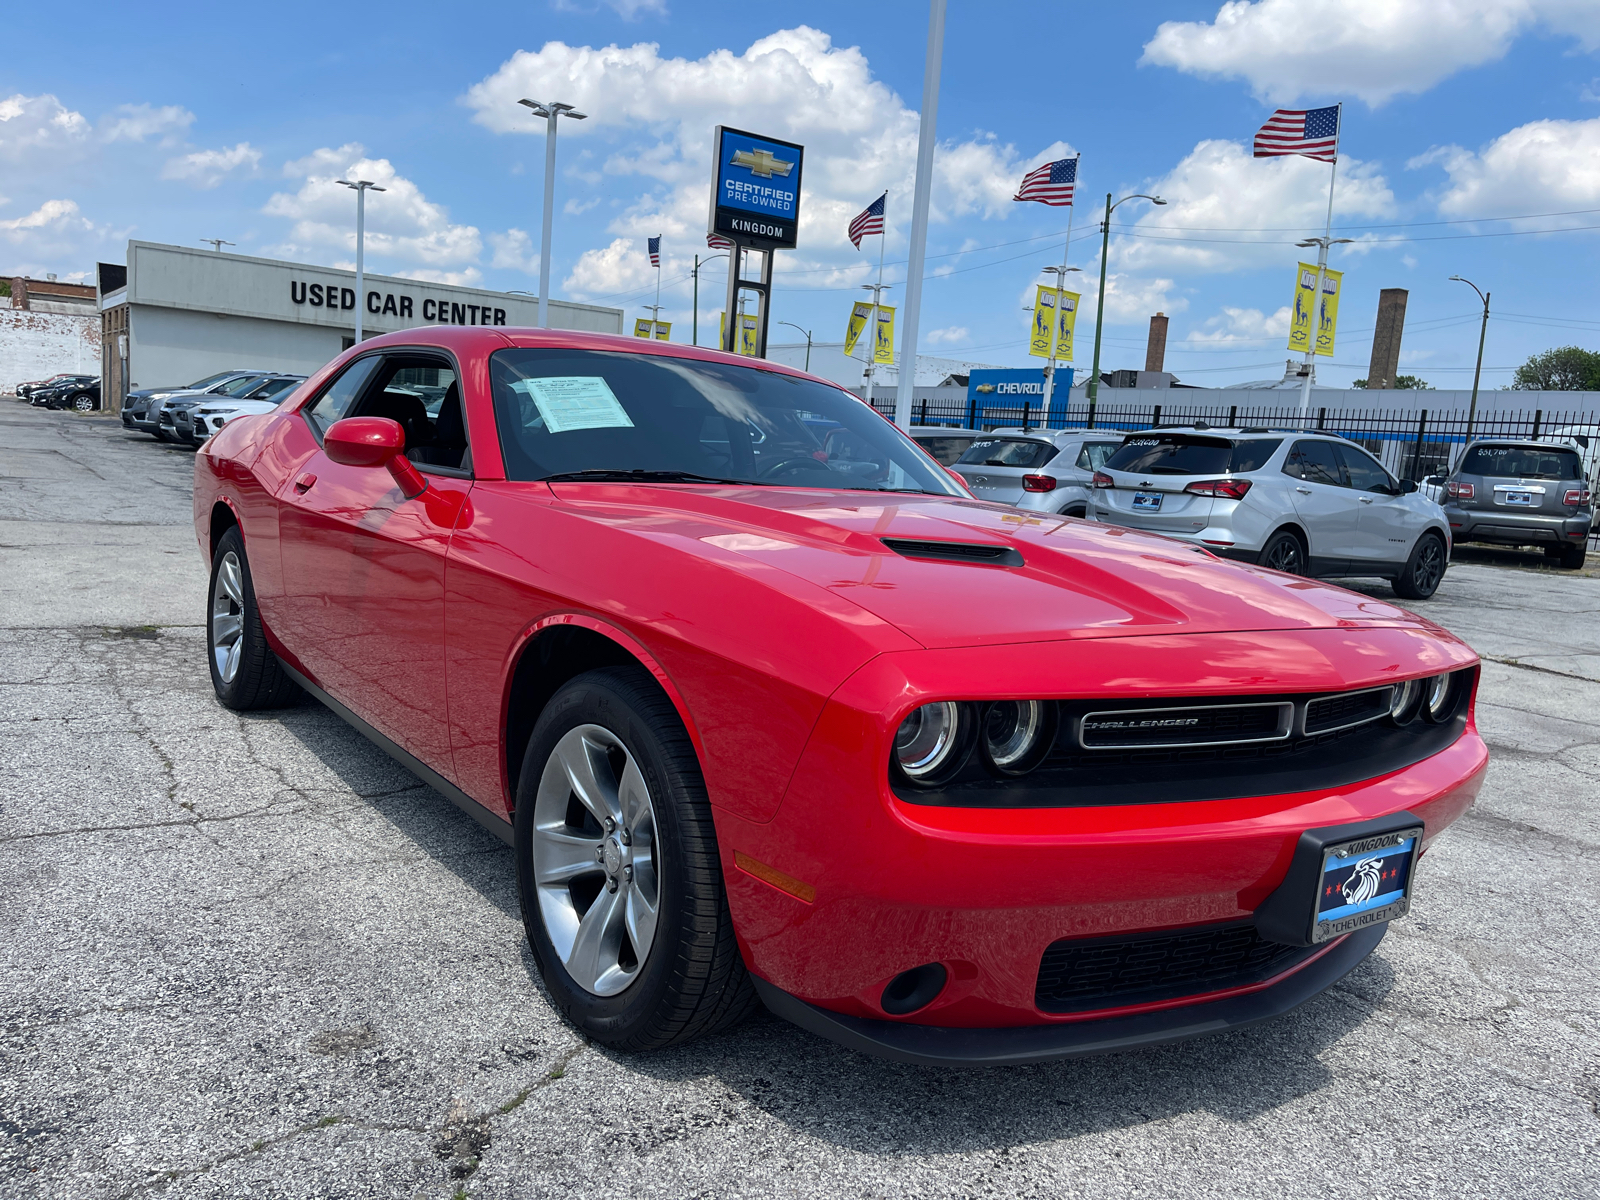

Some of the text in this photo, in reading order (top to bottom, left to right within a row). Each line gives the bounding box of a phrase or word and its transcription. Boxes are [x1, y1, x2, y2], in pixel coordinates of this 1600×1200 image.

[725, 179, 794, 202] CERTIFIED
[727, 190, 791, 211] PRE-OWNED
[731, 219, 783, 238] KINGDOM
[291, 280, 507, 326] USED CAR CENTER
[1040, 290, 1056, 309] King
[996, 382, 1057, 395] CHEVROLT
[1083, 718, 1199, 730] CHALLENGER
[1347, 833, 1400, 855] KINGDOM
[1335, 908, 1388, 933] CHEVROLET
